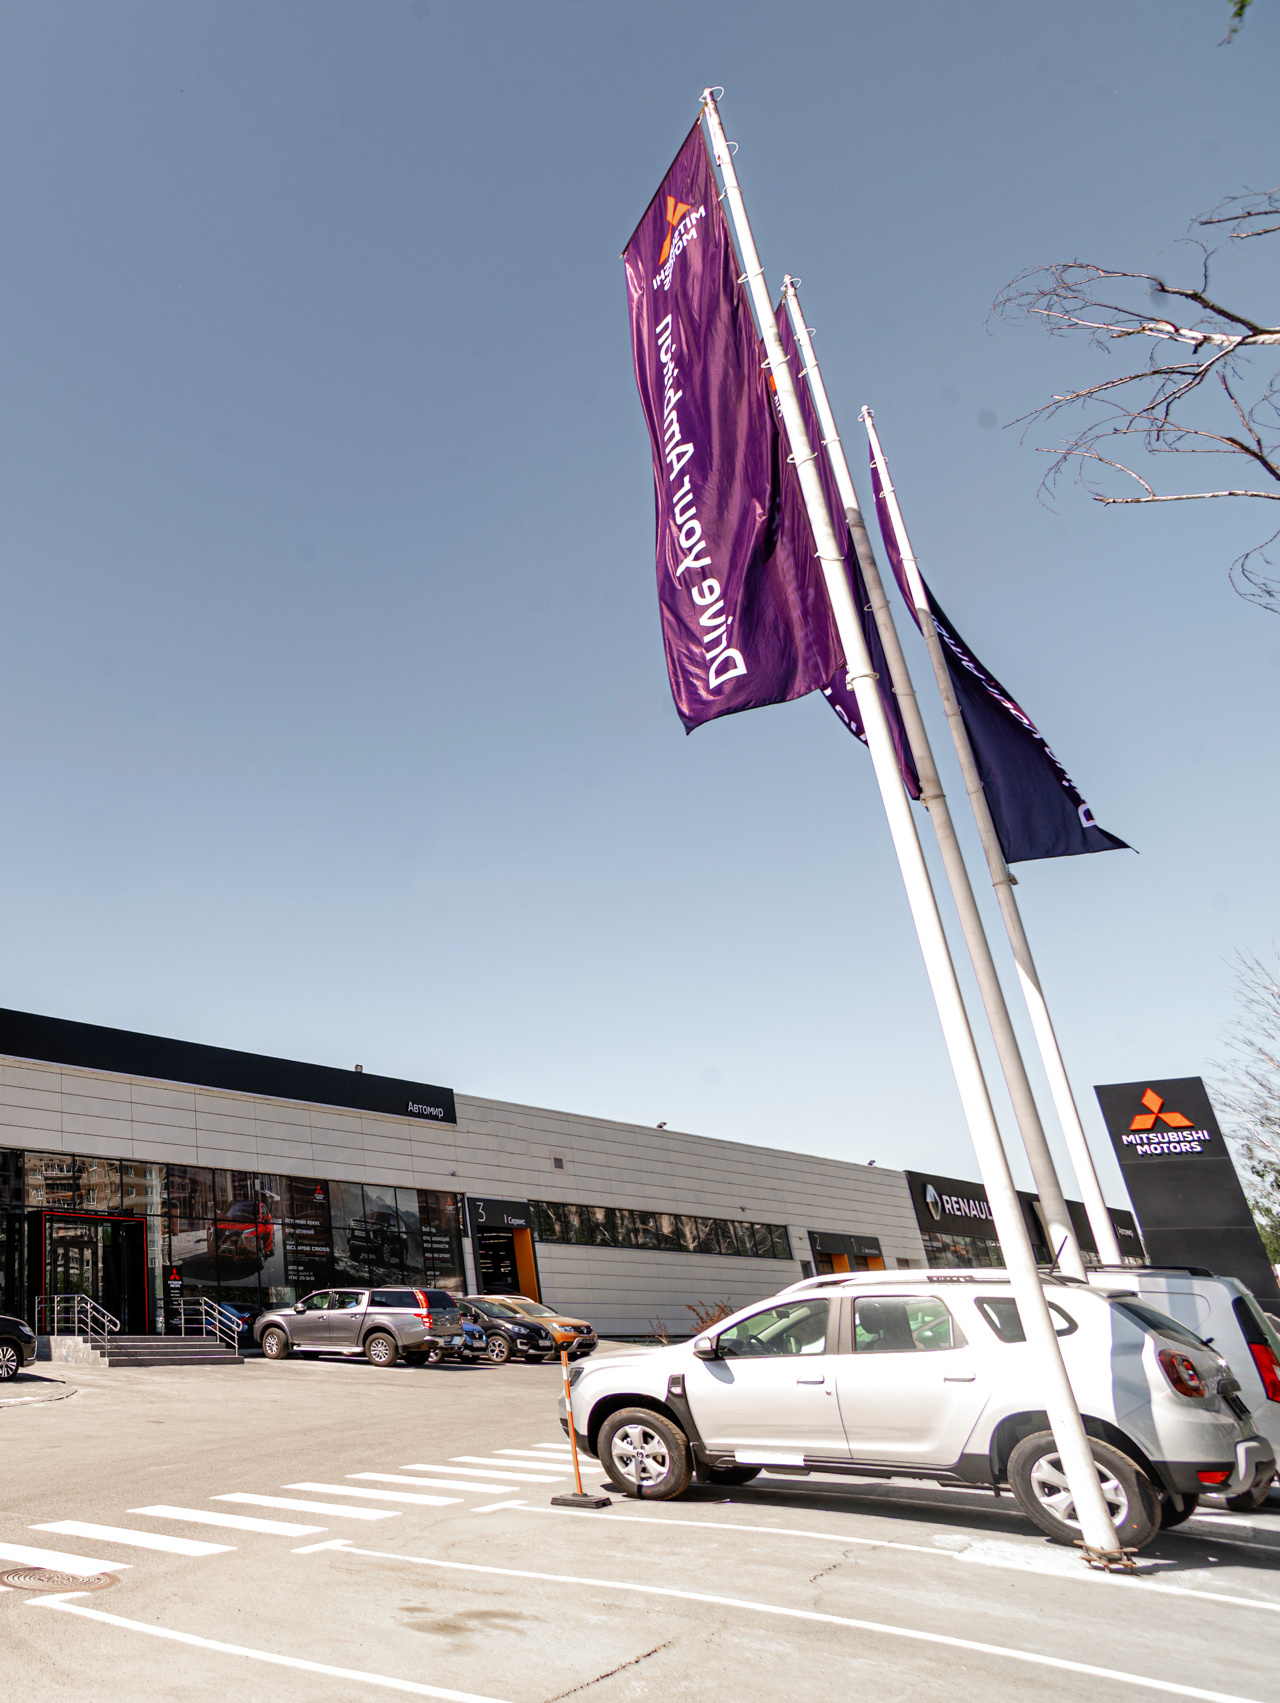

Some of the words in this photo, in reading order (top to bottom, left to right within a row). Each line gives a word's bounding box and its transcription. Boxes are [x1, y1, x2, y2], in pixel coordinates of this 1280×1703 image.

[408, 1101, 444, 1119] Автомир
[1122, 1129, 1210, 1145] MITSUBISHI
[1136, 1141, 1202, 1156] MOTORS
[476, 1201, 486, 1222] 3
[941, 1194, 994, 1220] RENAUL
[508, 1216, 526, 1226] Сервис
[814, 1234, 821, 1250] 2
[851, 1238, 857, 1252] 1
